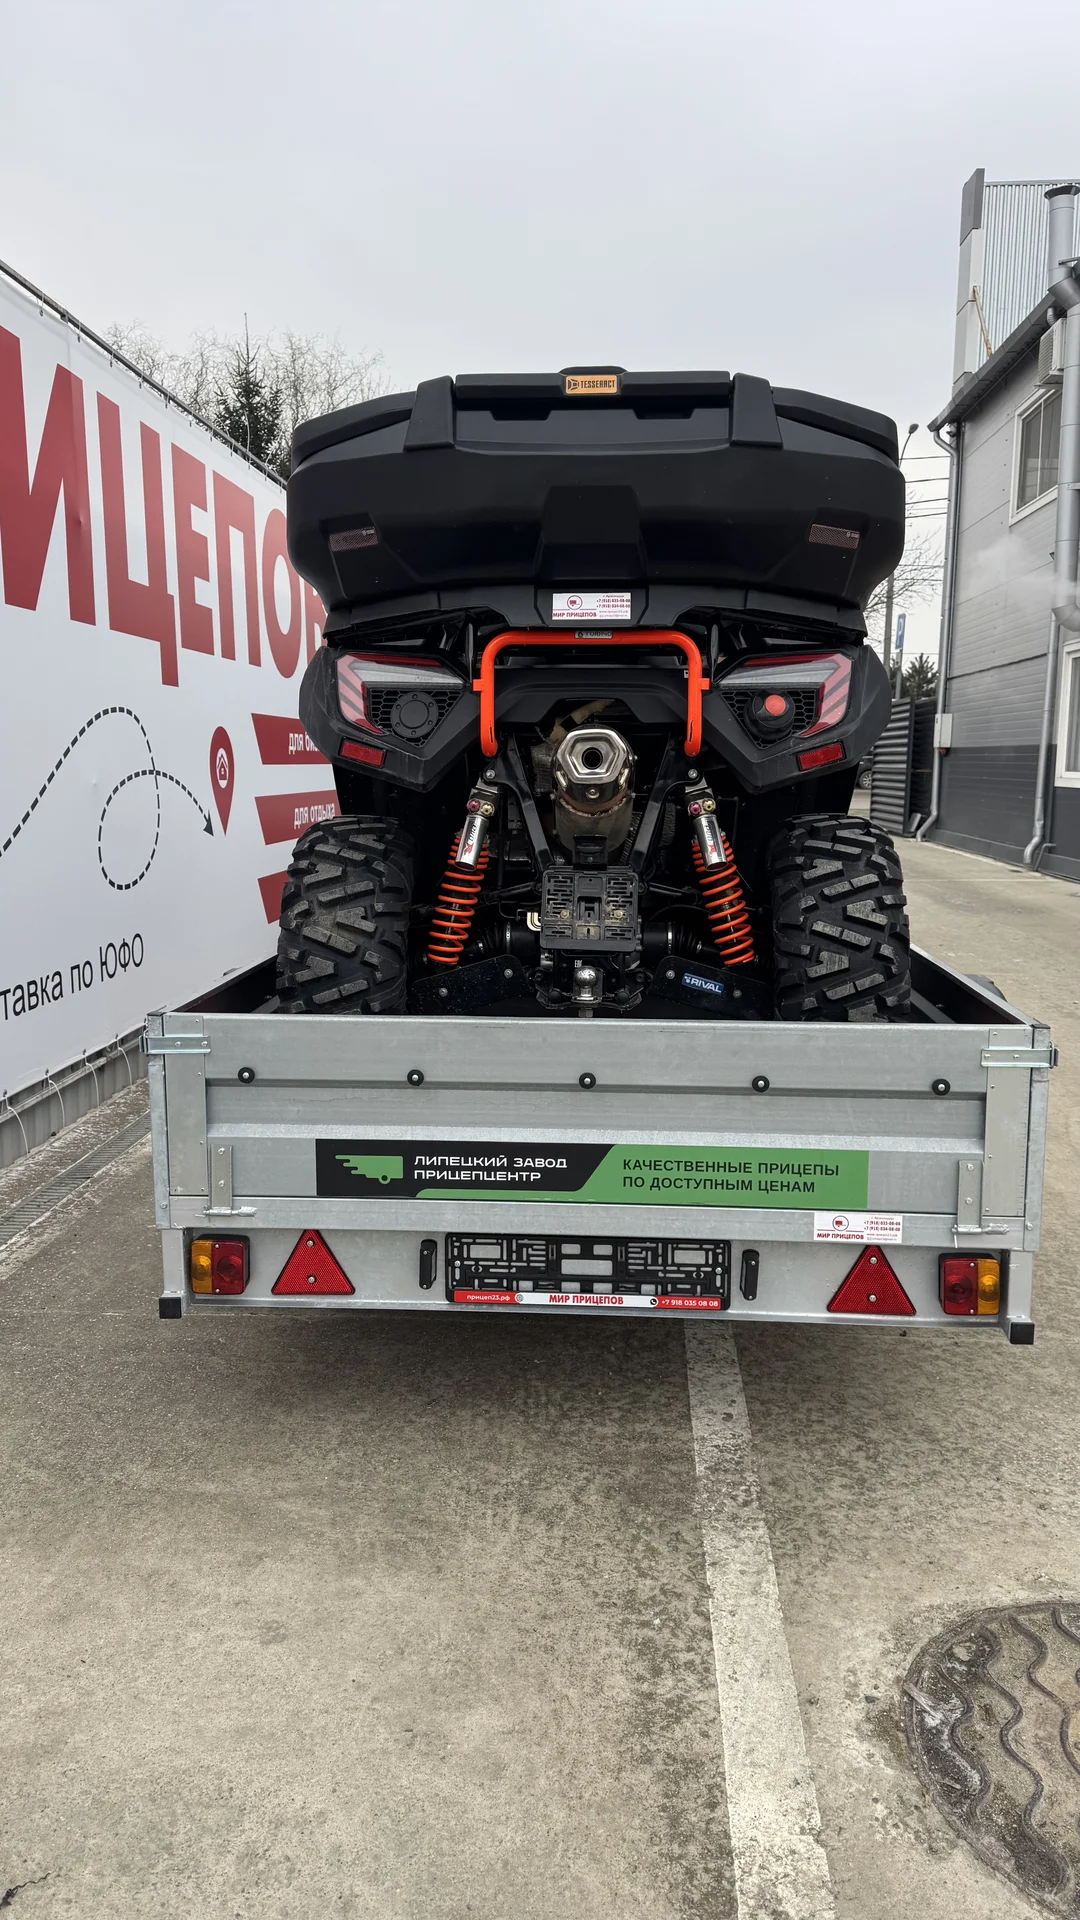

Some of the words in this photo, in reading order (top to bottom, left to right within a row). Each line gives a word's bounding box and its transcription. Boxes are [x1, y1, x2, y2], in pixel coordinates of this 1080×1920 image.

[581, 380, 615, 388] TESSERACT
[289, 733, 304, 754] для
[294, 808, 309, 829] для
[310, 803, 335, 822] отдыха
[70, 960, 93, 994] по
[99, 933, 144, 982] ЮФО
[690, 978, 722, 993] RIVAL
[414, 1155, 508, 1167] ЛИПЕЦКИЙ
[513, 1158, 568, 1169] ЗАВОД
[623, 1159, 752, 1174] КАЧЕСТВЕННЫЕ
[758, 1162, 839, 1177] ПРИЦЕПЫ
[414, 1170, 541, 1182] ПРИЦЕПЦЕНТР
[622, 1176, 645, 1188] ПО
[650, 1177, 752, 1191] ДОСТУПНЫМ
[758, 1180, 815, 1194] ЦЕНАМ
[467, 1294, 510, 1302] прицеп23.рф
[549, 1295, 570, 1303] МИР
[572, 1295, 624, 1305] ПРИЦЕПОВ
